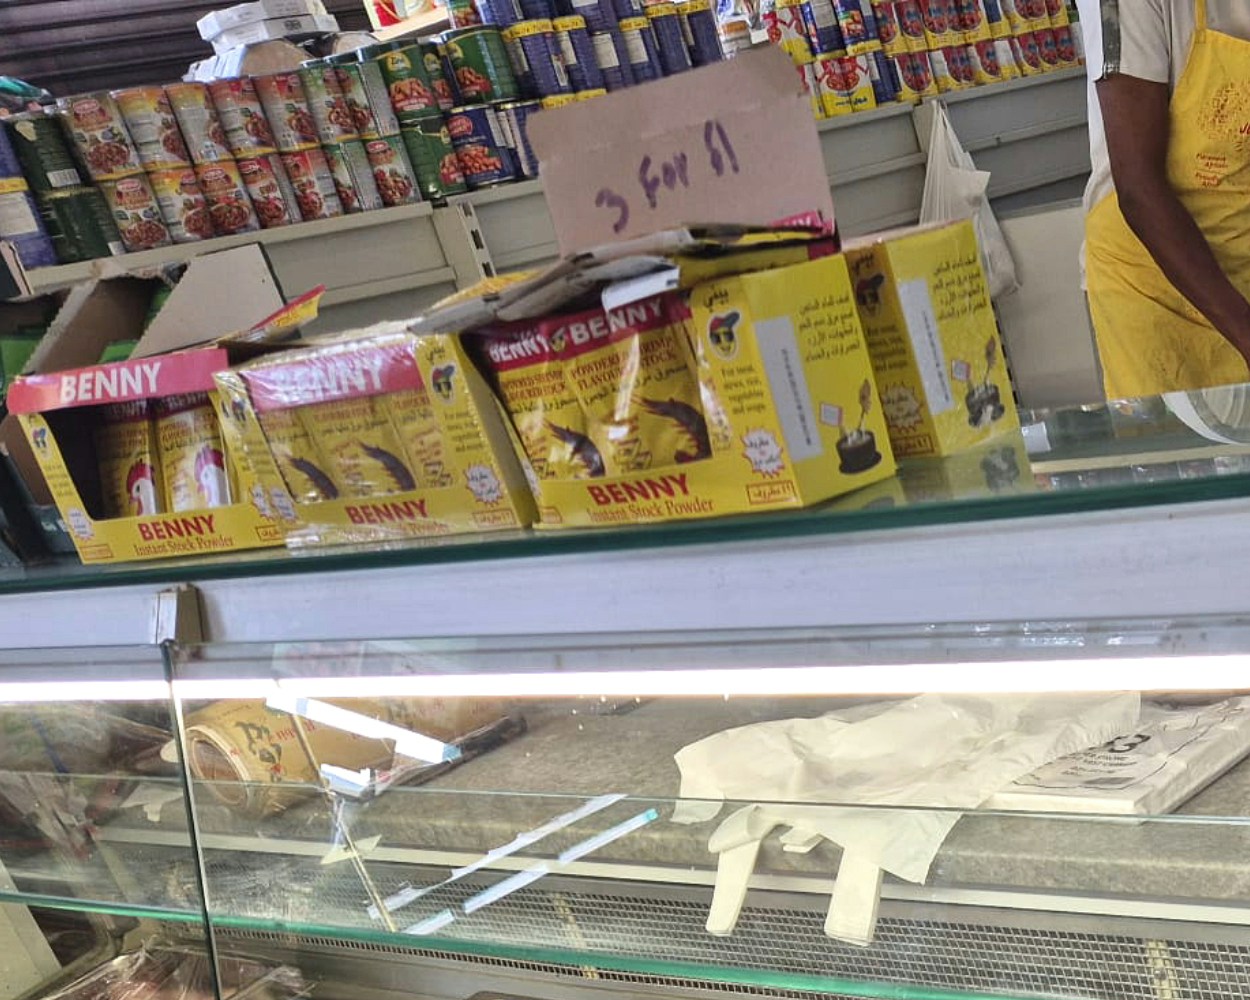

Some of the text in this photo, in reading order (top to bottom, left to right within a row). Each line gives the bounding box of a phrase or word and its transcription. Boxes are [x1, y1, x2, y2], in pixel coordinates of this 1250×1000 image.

[595, 188, 629, 233] 3
[638, 151, 690, 210] for
[569, 299, 663, 345] BENNY
[489, 333, 549, 363] BENNY
[60, 361, 162, 405] BENNY
[586, 472, 690, 507] BENNY
[344, 497, 428, 525] BENNY
[628, 501, 664, 518] Stock
[665, 495, 714, 516] Powder
[138, 513, 215, 541] BENNY
[133, 533, 234, 557] Instant Stock Powder
